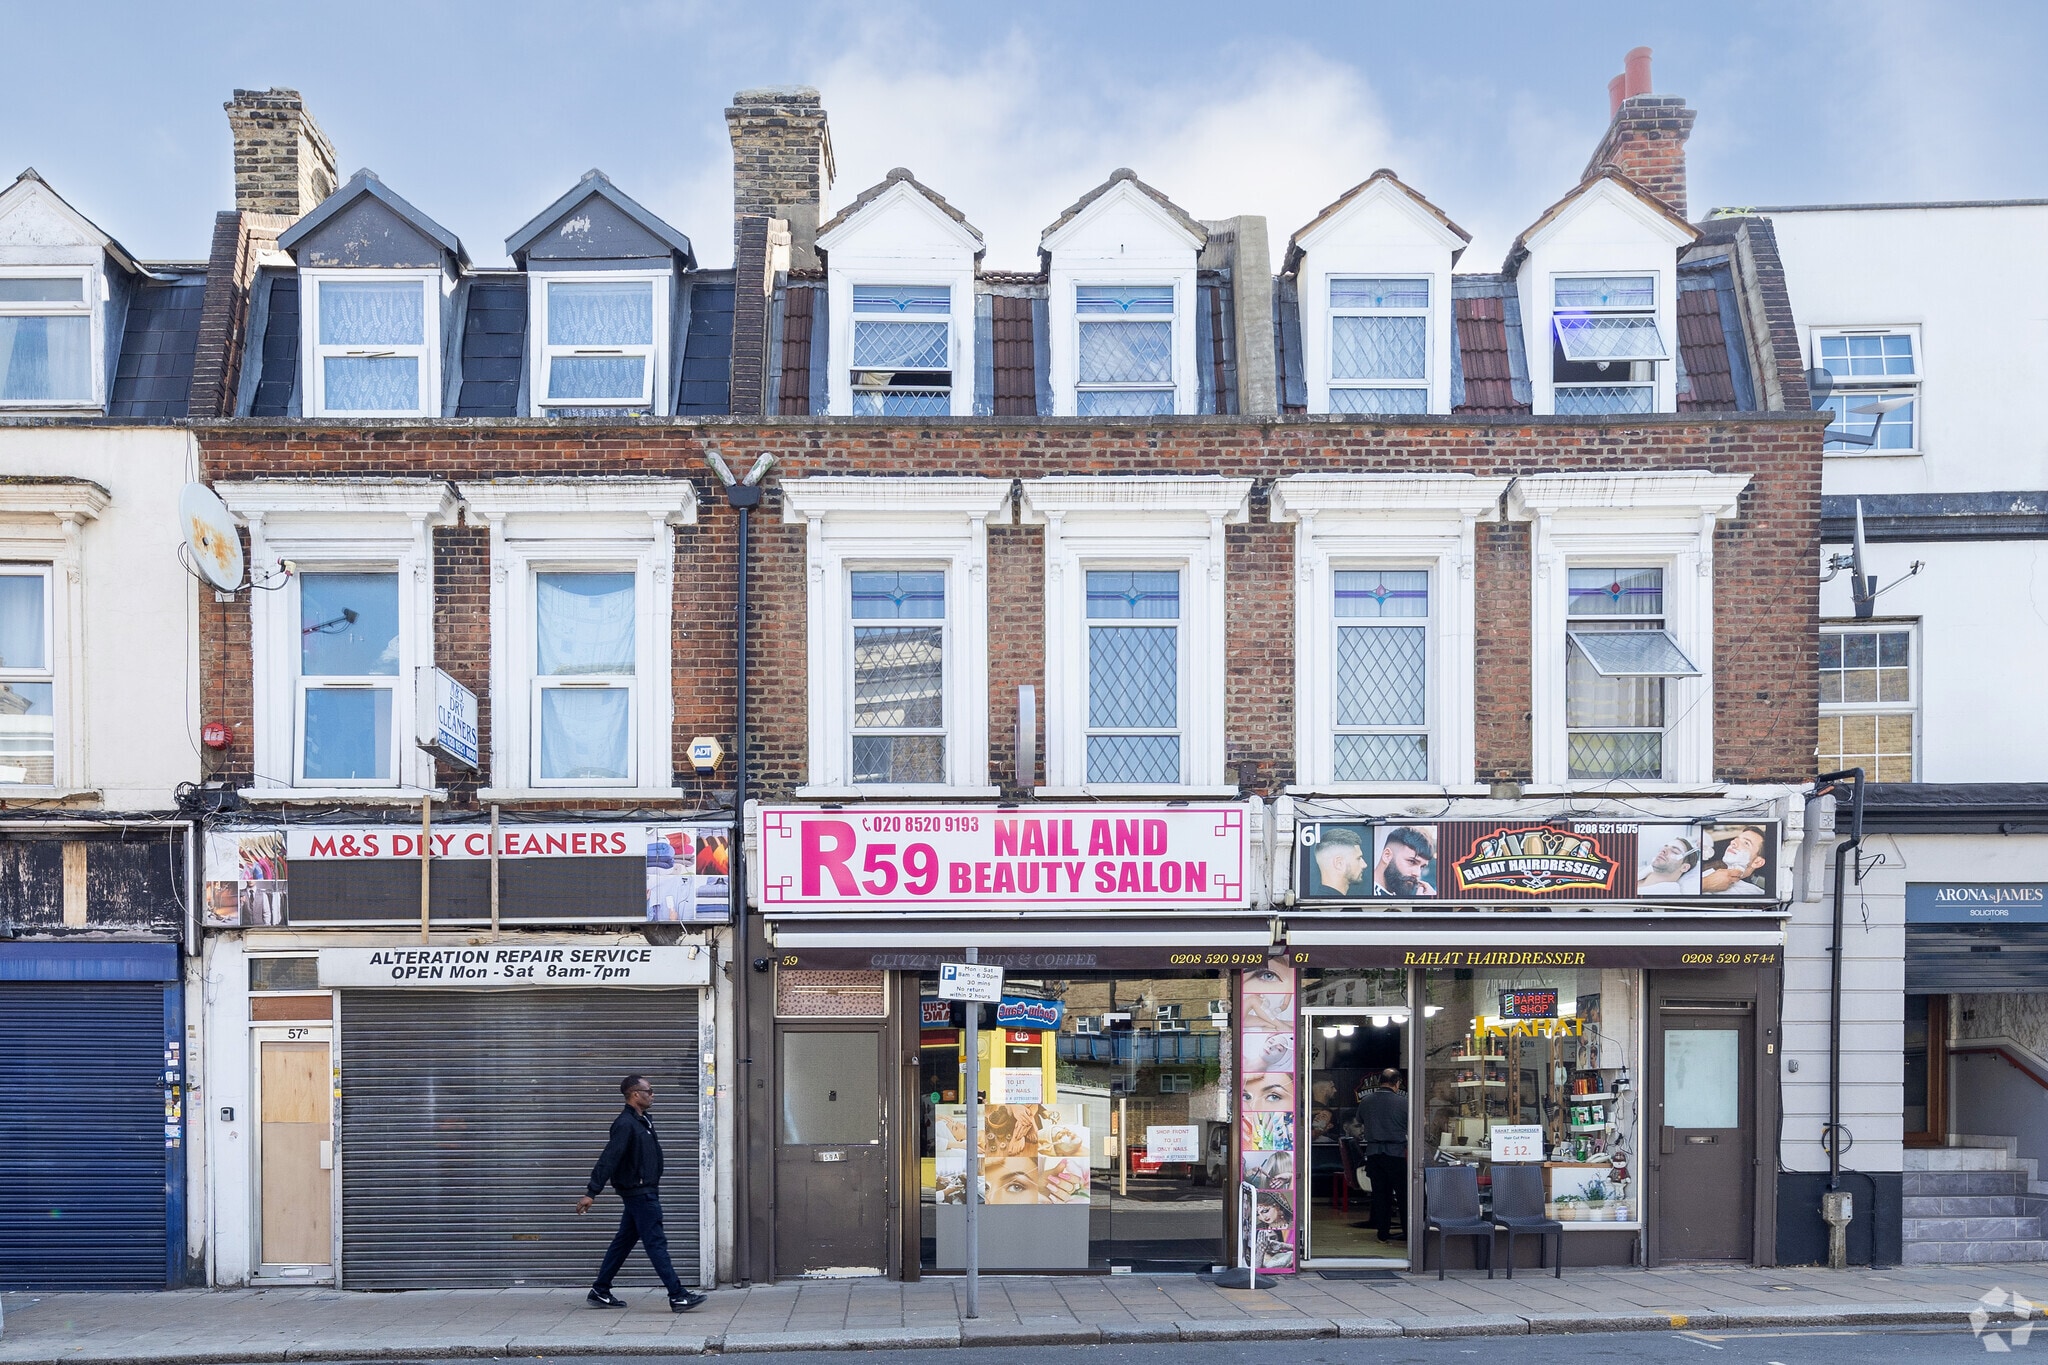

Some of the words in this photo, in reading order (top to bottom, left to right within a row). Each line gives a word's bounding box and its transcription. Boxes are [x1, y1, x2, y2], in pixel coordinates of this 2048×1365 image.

[450, 696, 464, 717] DRY
[438, 705, 477, 747] CLEANERS
[873, 816, 900, 833] 020
[905, 816, 941, 832] 8520
[945, 816, 979, 832] 9193
[1574, 824, 1598, 834] 0208
[1599, 824, 1615, 833] 521
[1616, 824, 1638, 834] 5075
[309, 833, 380, 857] M&S
[392, 833, 456, 856] DRY
[464, 831, 627, 855] CLEANERS
[994, 819, 1079, 857] NAIL
[1088, 819, 1168, 856] AND
[949, 862, 1086, 893] BEAUTY
[1094, 861, 1207, 893] SALON
[1463, 860, 1506, 881] RAHAT
[1508, 858, 1608, 881] HAIRDRESSERS
[1935, 888, 1988, 901] ARONA
[1994, 888, 2043, 904] JAMES
[370, 950, 489, 965] ALTERATION
[495, 950, 563, 963] REPAIR
[569, 949, 651, 963] SERVICE
[782, 955, 799, 966] 59
[870, 954, 932, 967] GLITZY
[934, 954, 1015, 967] DESERTS
[1035, 953, 1097, 967] COFFEE
[1170, 954, 1201, 965] 0208
[1204, 954, 1228, 964] 520
[1230, 953, 1263, 964] 9193
[1295, 952, 1310, 963] 61
[1403, 952, 1463, 965] RAHAT
[1465, 951, 1586, 965] HAIRDRESSER
[1681, 953, 1713, 964] 0208
[1716, 953, 1740, 964] 520
[1743, 953, 1775, 964] 8744
[391, 966, 443, 979] OPEN
[450, 966, 487, 979] Mon
[503, 965, 534, 978] Sat
[546, 964, 631, 980] 8am-7pm
[944, 966, 955, 980] P
[1514, 994, 1555, 1004] BARBER
[1520, 1004, 1549, 1013] SHOP
